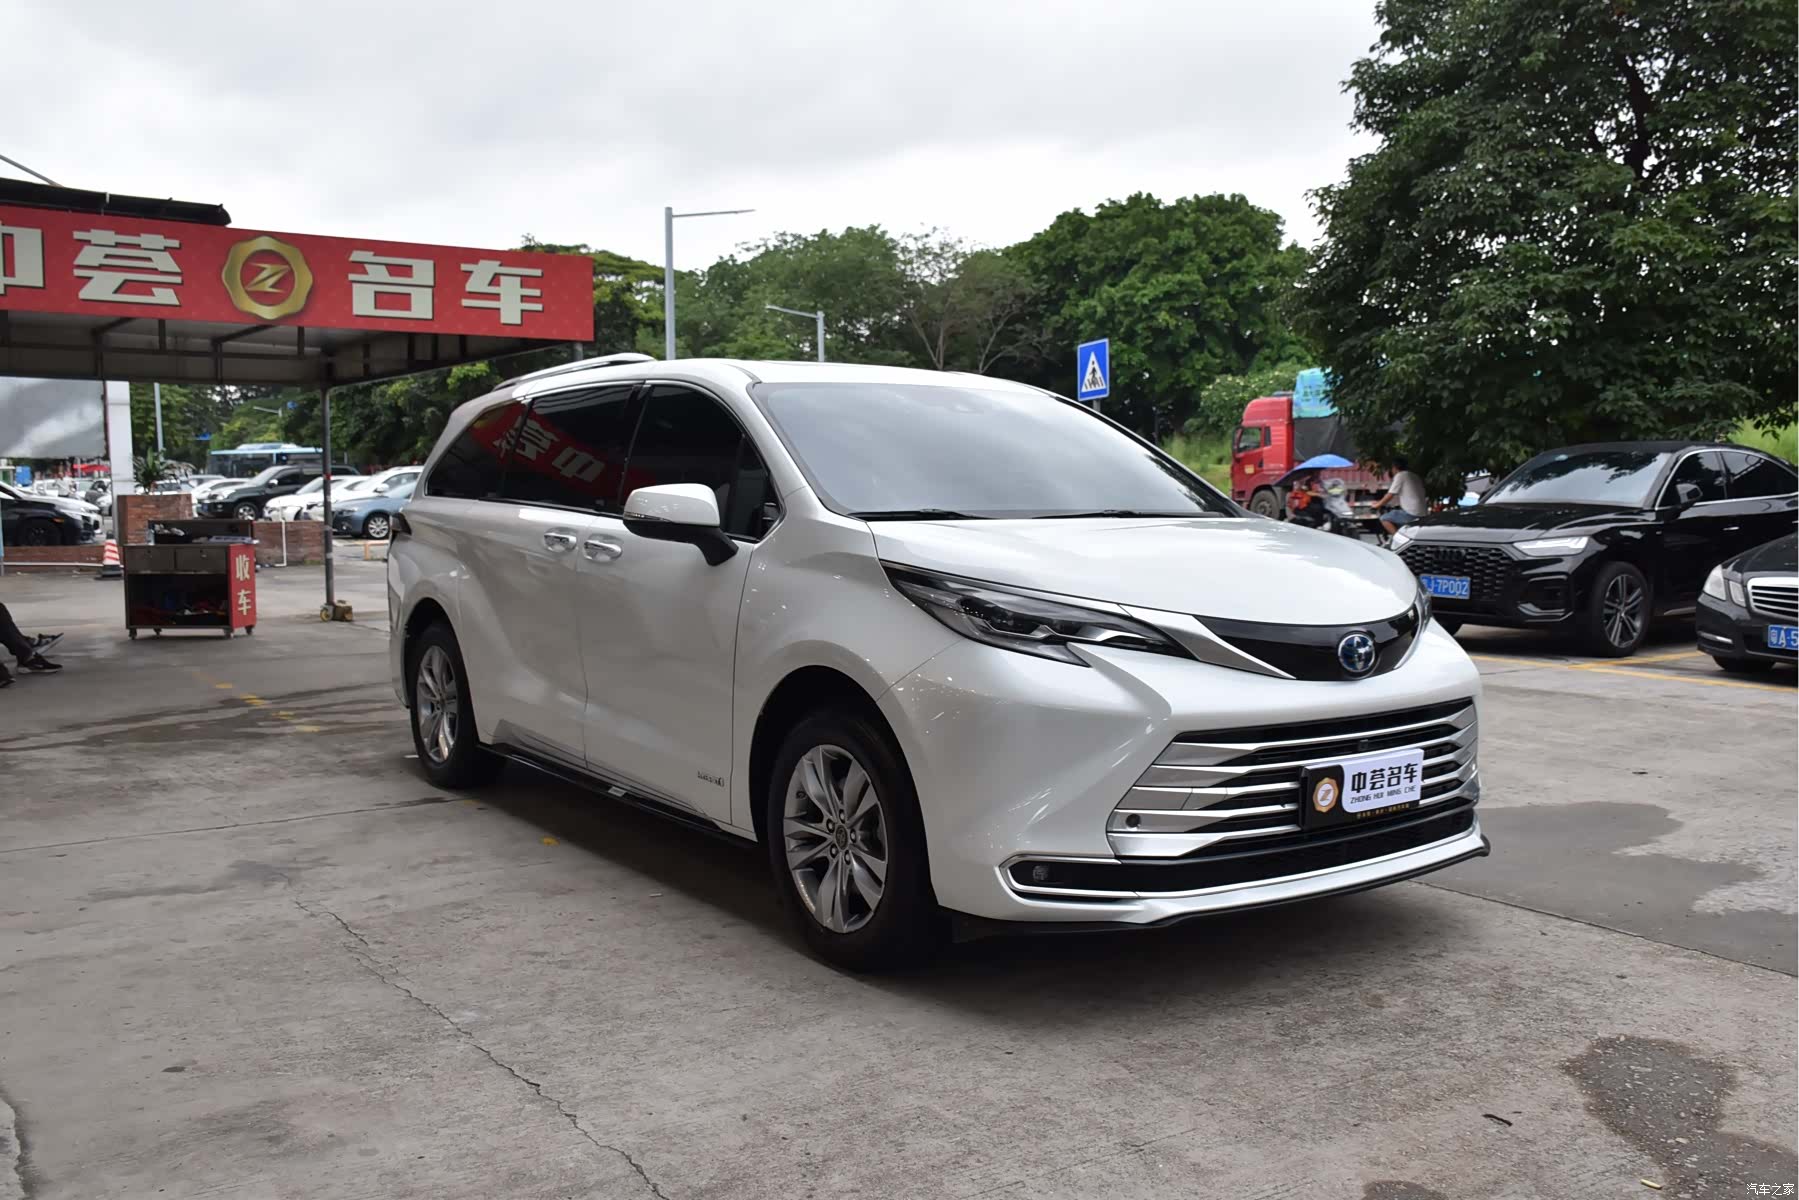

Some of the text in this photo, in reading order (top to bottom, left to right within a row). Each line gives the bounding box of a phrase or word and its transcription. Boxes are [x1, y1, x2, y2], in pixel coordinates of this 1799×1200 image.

[348, 250, 543, 325] 名车
[236, 554, 251, 616] 收车
[1351, 763, 1418, 793] 中荟名车
